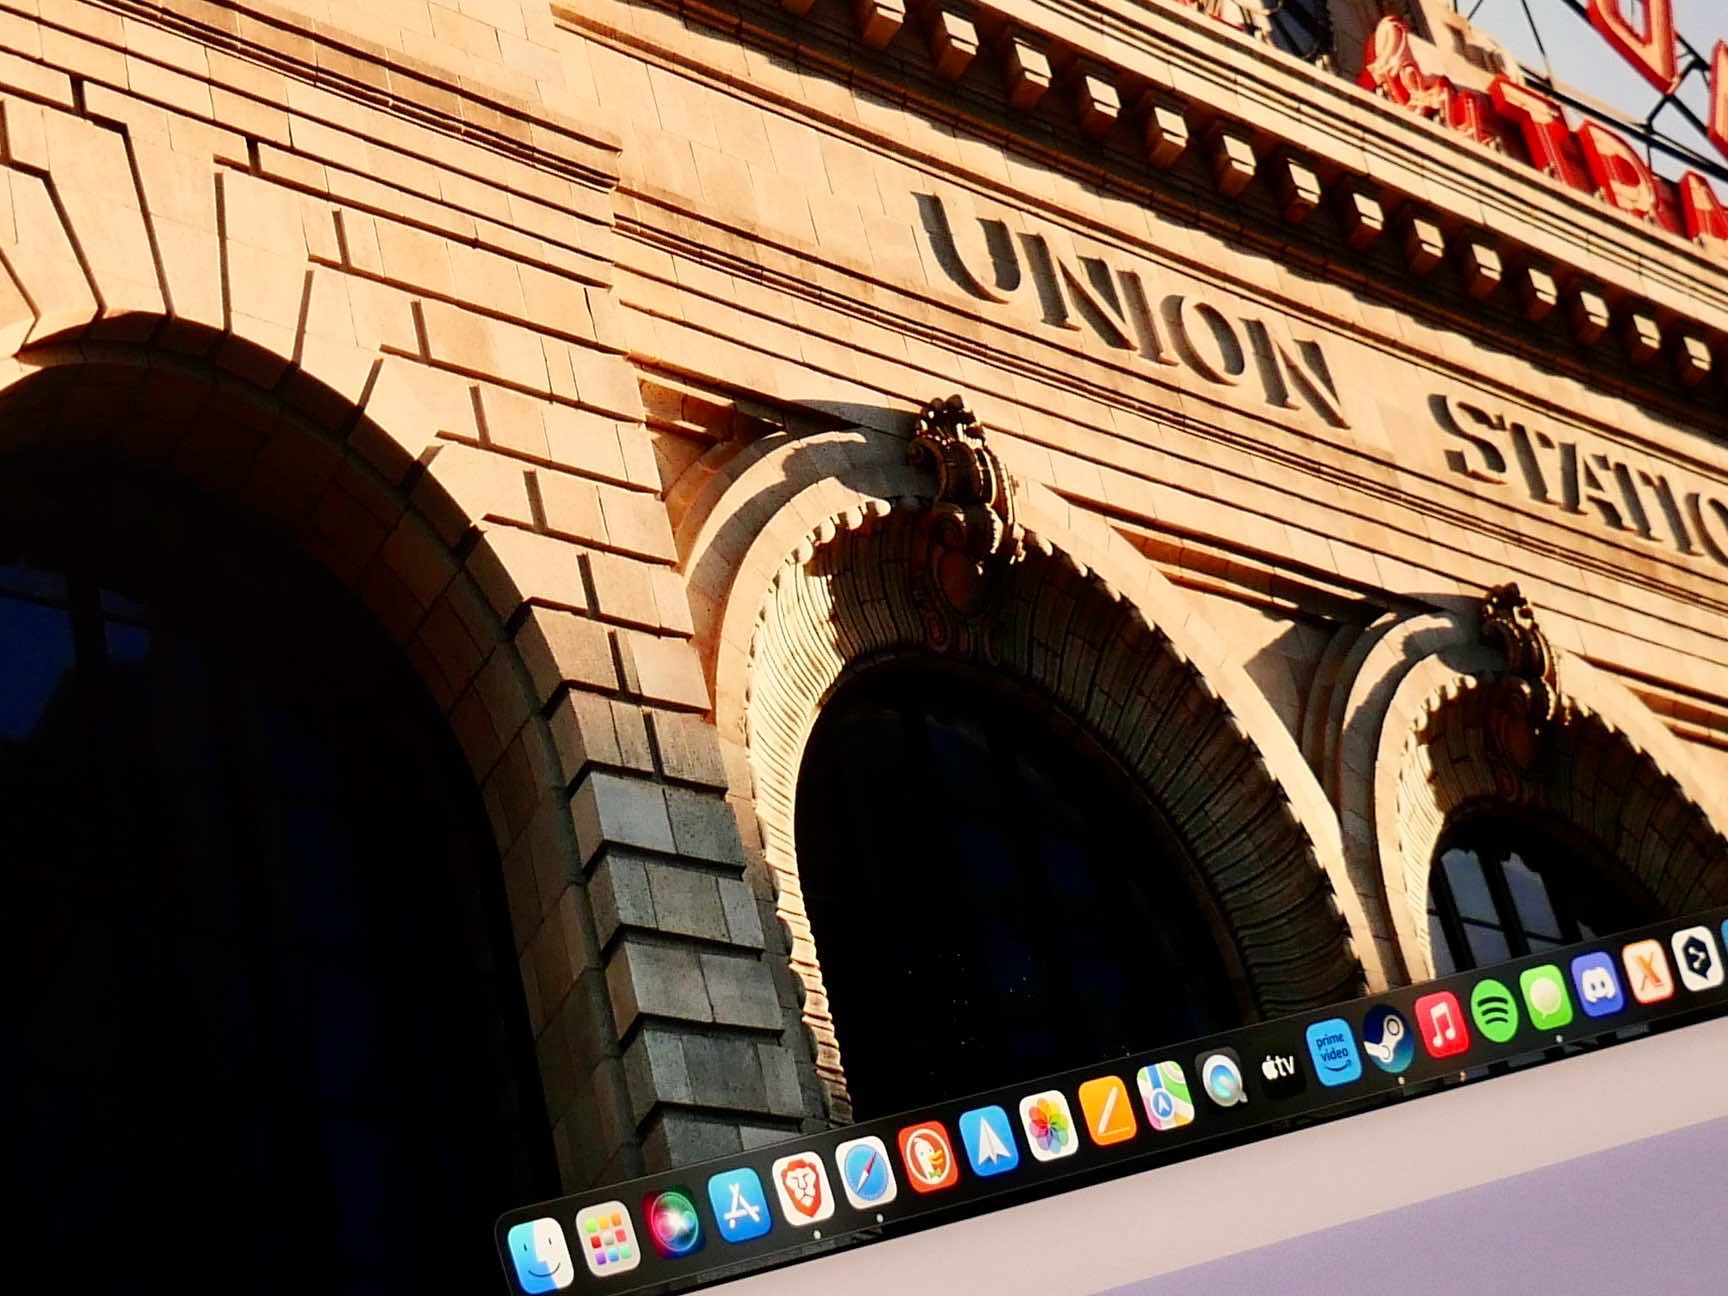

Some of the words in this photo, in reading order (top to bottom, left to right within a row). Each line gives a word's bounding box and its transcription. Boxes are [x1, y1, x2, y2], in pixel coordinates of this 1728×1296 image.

[910, 190, 1352, 430] UNION
[1315, 1032, 1345, 1050] prime
[1321, 1047, 1349, 1063] video
